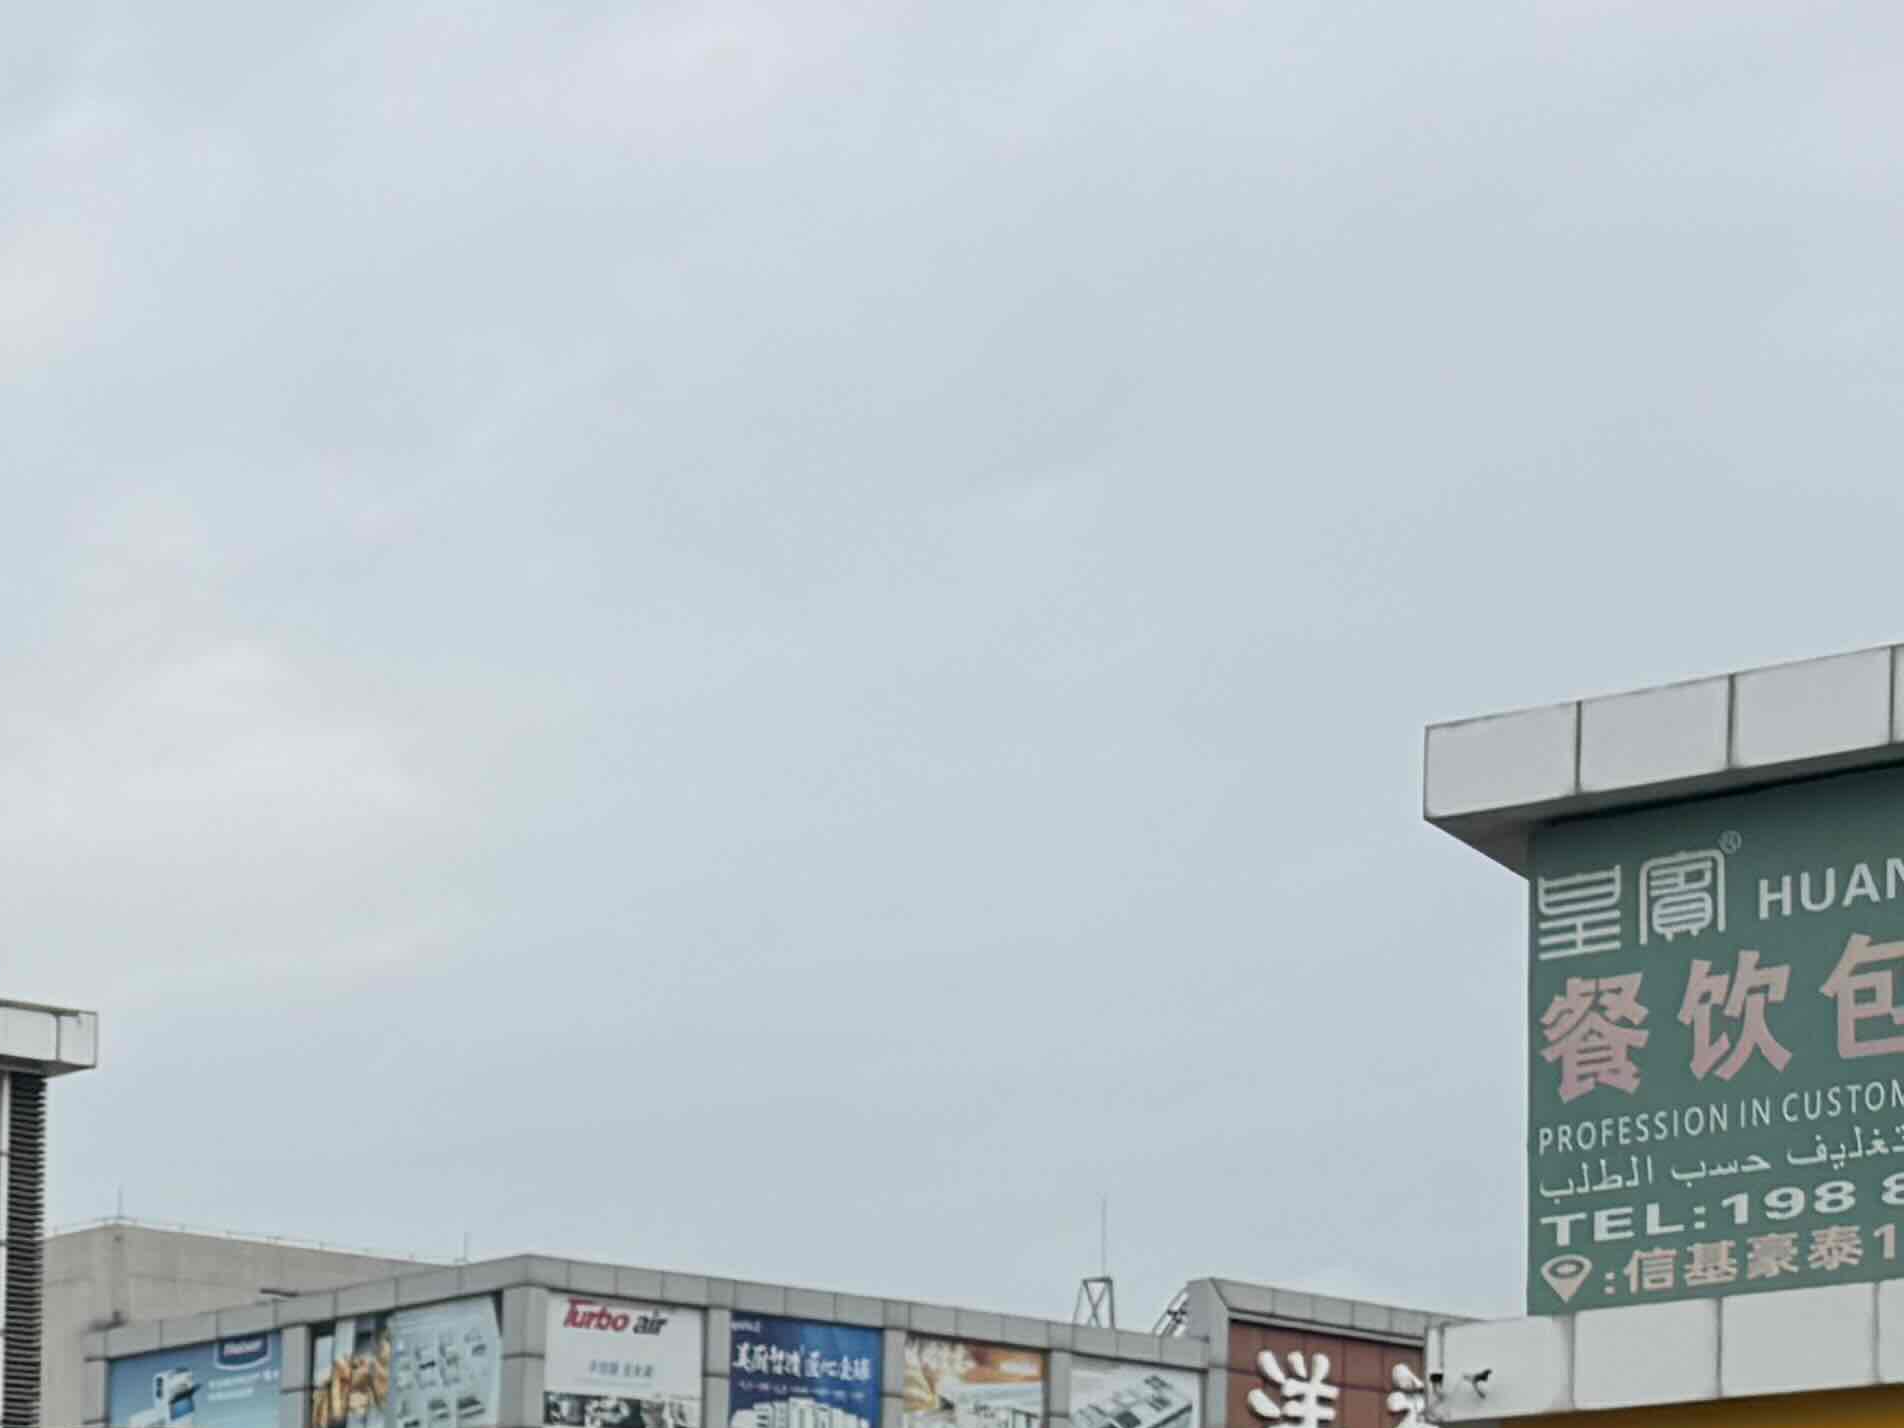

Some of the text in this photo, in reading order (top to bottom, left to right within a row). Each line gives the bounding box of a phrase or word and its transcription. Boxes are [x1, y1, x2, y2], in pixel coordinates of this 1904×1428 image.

[1540, 932, 1904, 1103] 餐饮包
[1539, 1103, 1729, 1155] PROFESSION
[1740, 1097, 1771, 1130] IN
[1539, 1155, 1653, 1205] الطلب
[563, 1296, 668, 1336] Turbo air
